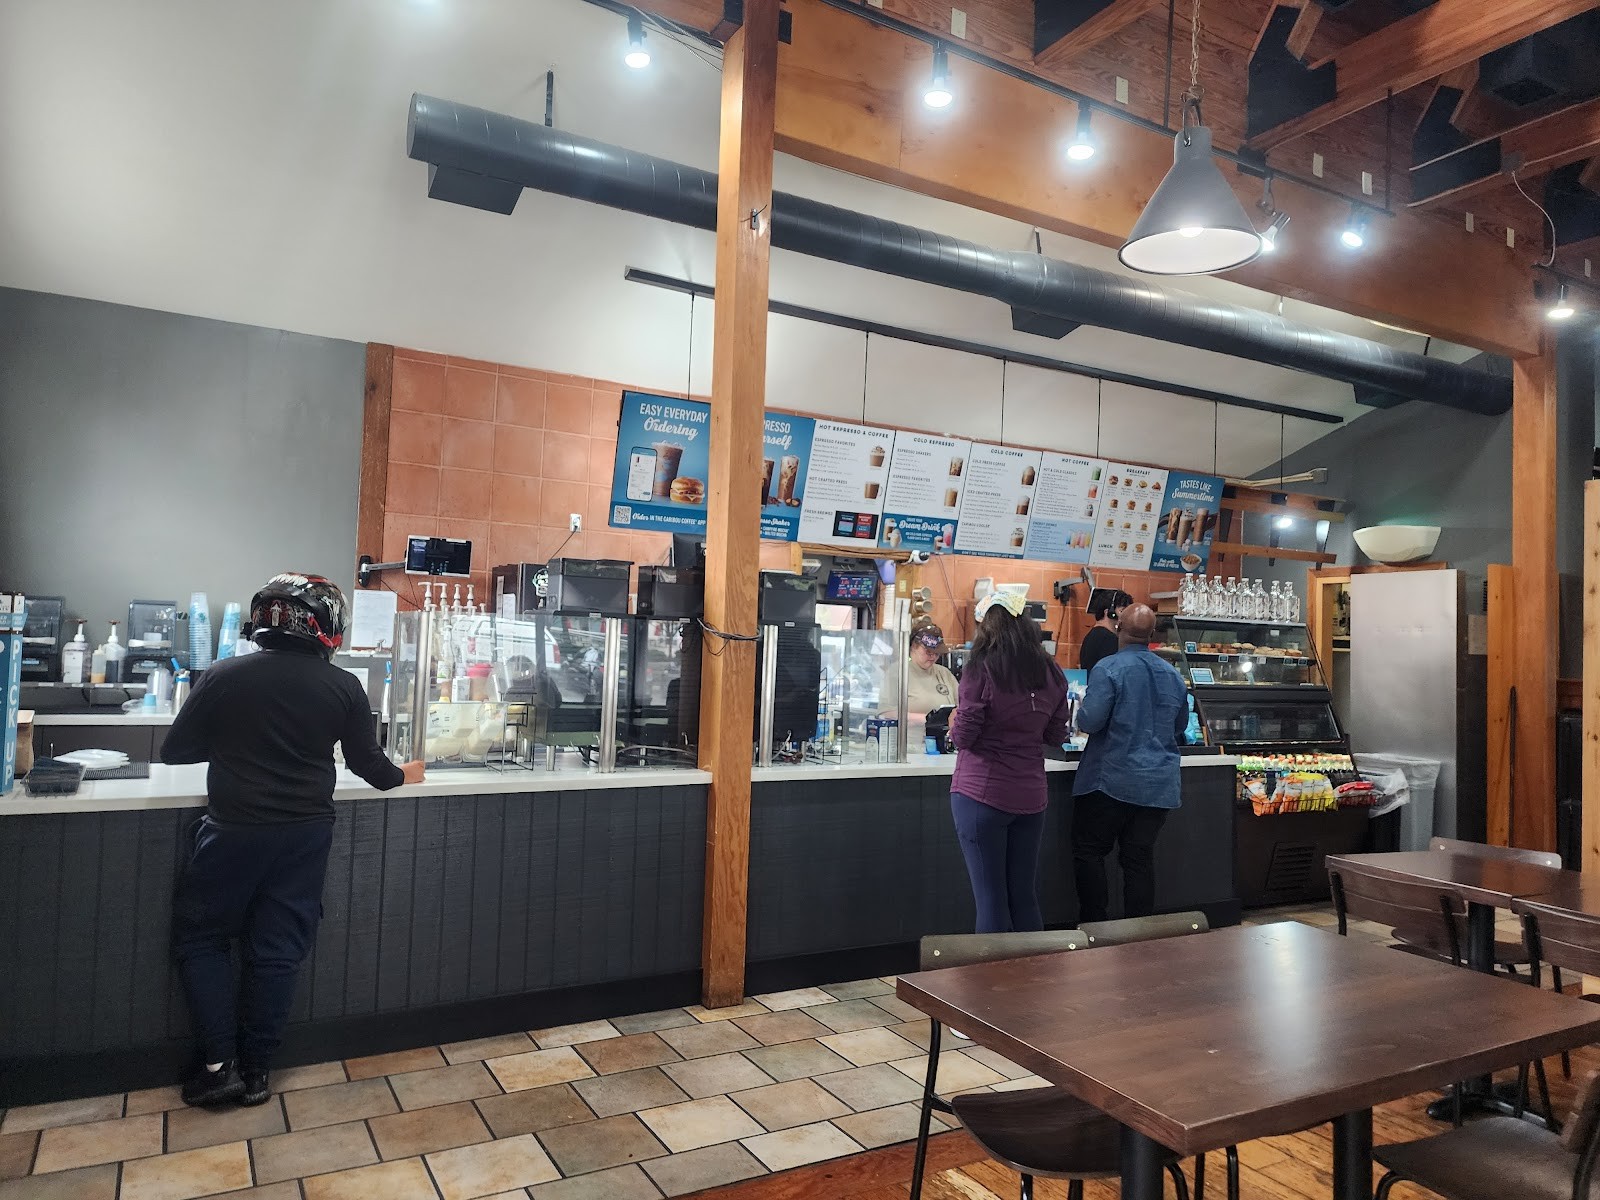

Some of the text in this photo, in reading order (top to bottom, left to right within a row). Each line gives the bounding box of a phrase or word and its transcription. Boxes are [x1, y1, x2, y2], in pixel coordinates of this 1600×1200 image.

[640, 403, 708, 423] EASY EVERYDAY
[644, 417, 698, 440] Ordering
[764, 420, 790, 434] RESSO
[1180, 480, 1212, 492] TASTES LIKE
[1172, 488, 1214, 502] Summertime
[899, 520, 940, 532] Dream Drink
[6, 639, 20, 785] PICK UP
